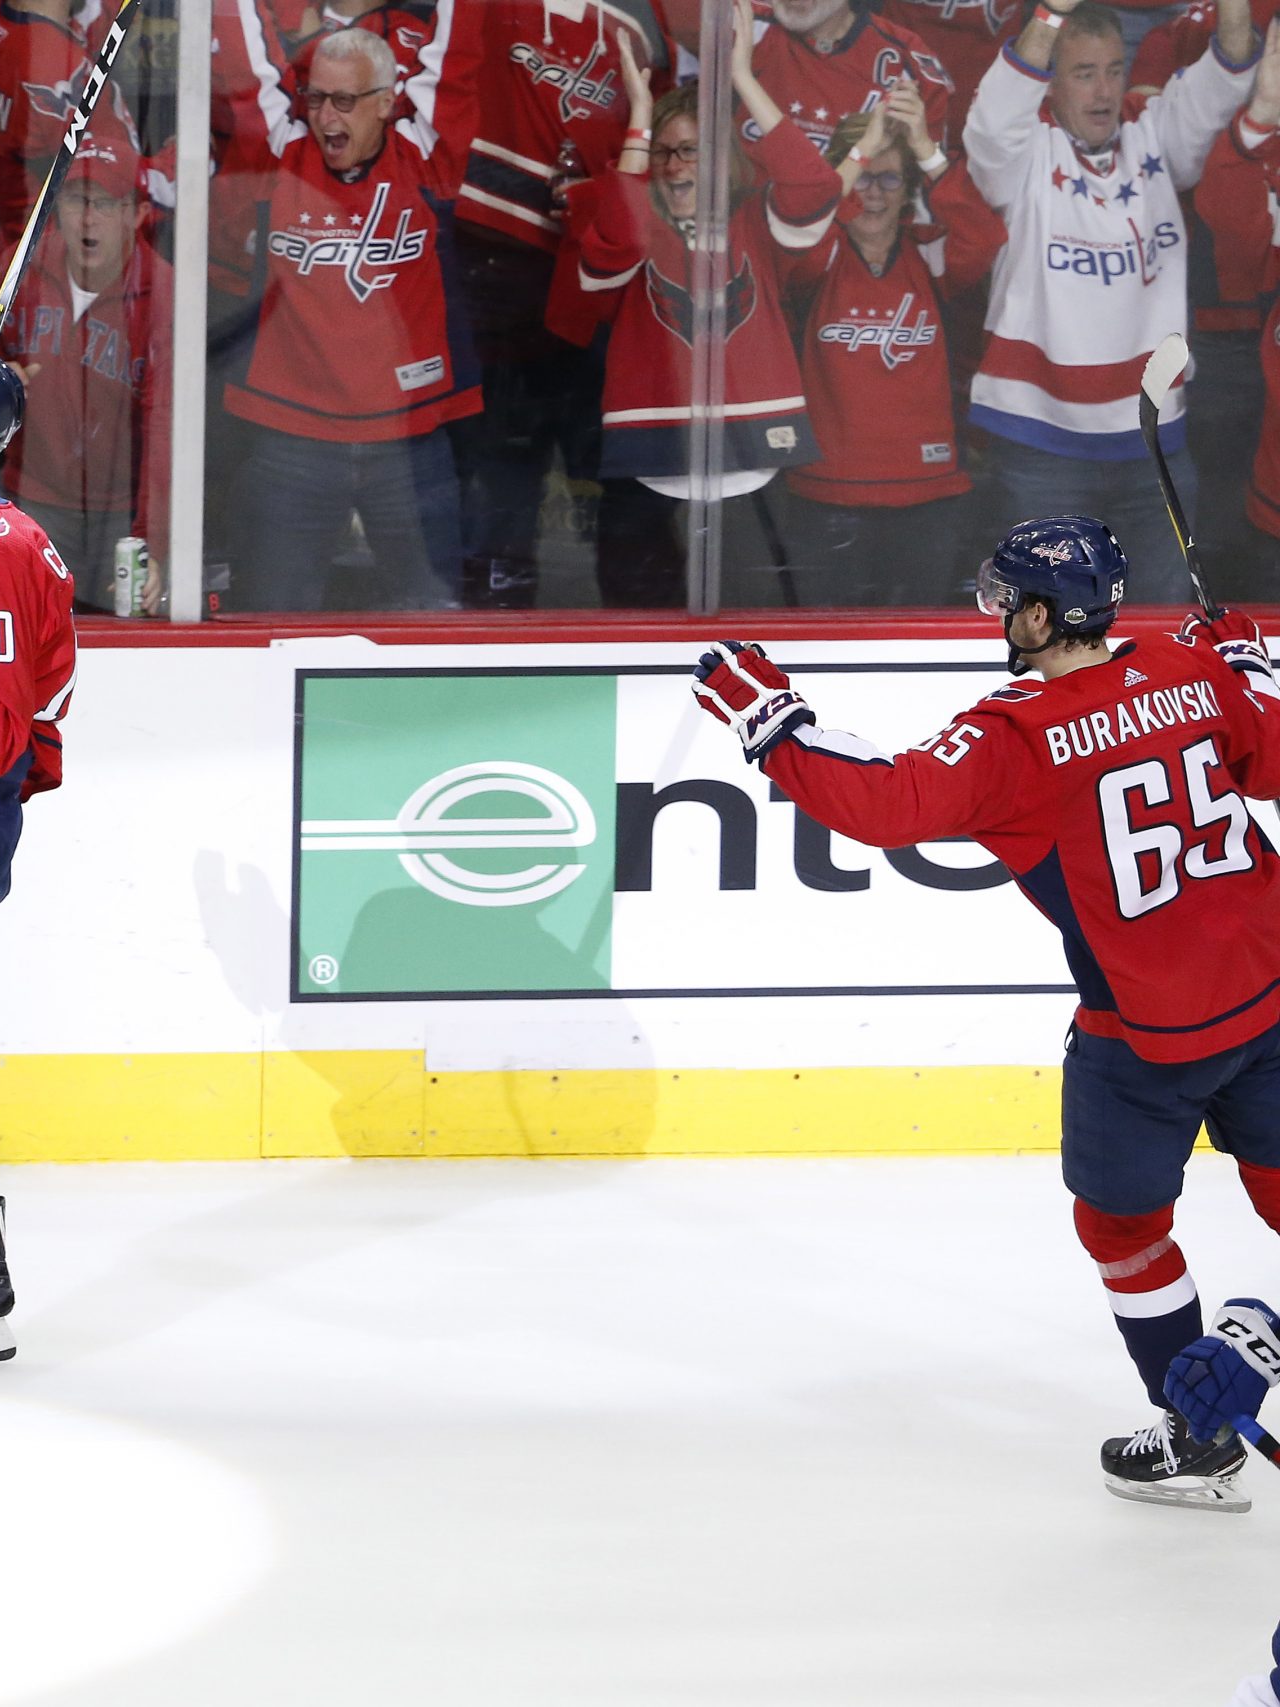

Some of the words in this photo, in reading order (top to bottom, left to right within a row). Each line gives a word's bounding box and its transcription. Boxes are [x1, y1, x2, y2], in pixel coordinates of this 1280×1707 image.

[63, 21, 126, 155] CCM
[269, 182, 428, 304] capitals
[817, 292, 938, 371] capitals
[1110, 579, 1125, 603] 65
[1097, 734, 1255, 921] 65
